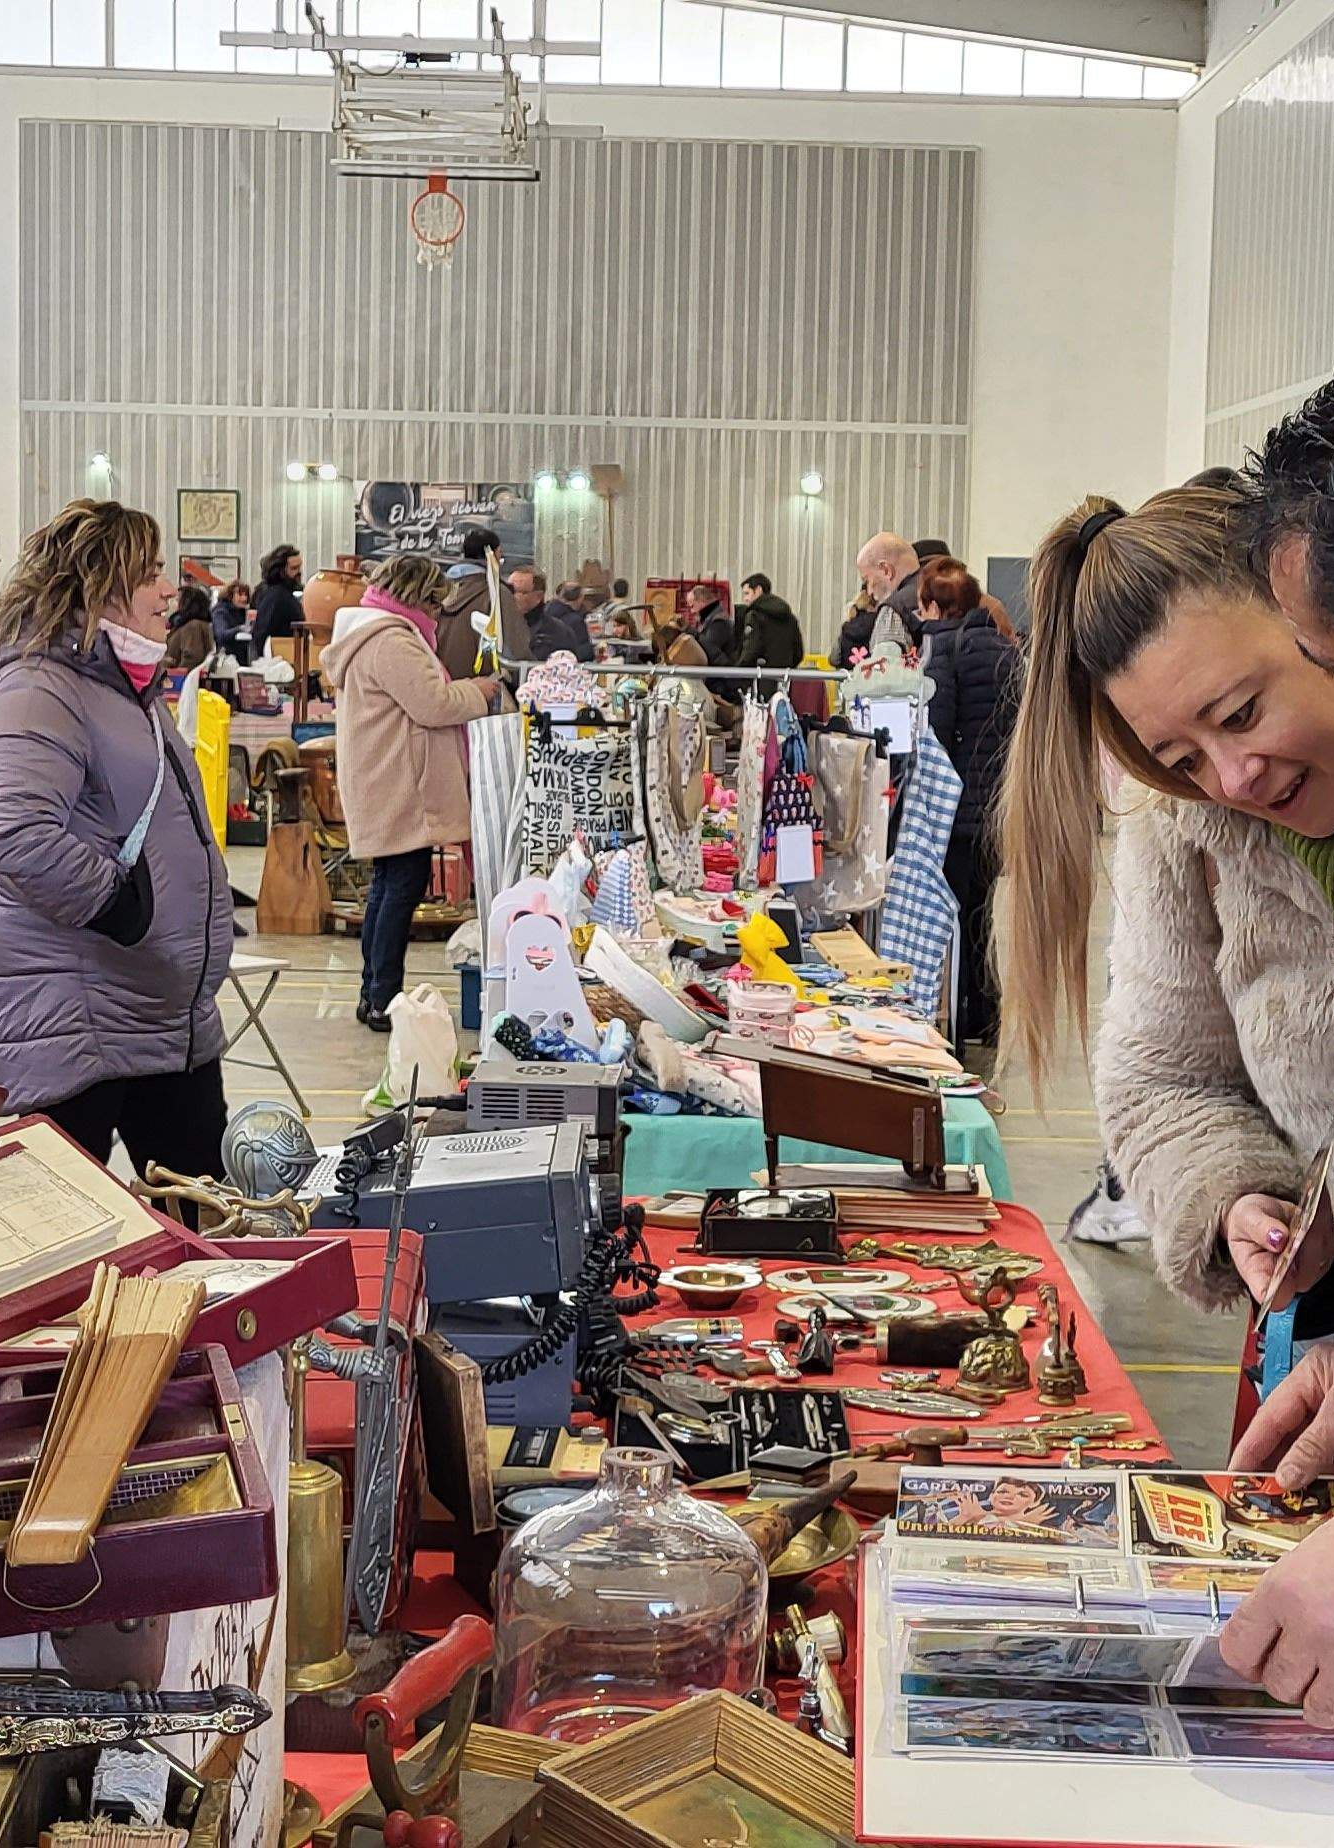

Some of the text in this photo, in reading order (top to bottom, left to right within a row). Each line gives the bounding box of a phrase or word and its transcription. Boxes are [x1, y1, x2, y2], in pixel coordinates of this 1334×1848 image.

[388, 503, 405, 525] El
[586, 740, 610, 816] LONDON
[529, 820, 544, 875] WALK
[904, 1479, 1112, 1501] GARLAND MASON
[898, 1519, 933, 1532] Une
[1166, 1493, 1206, 1542] 301
